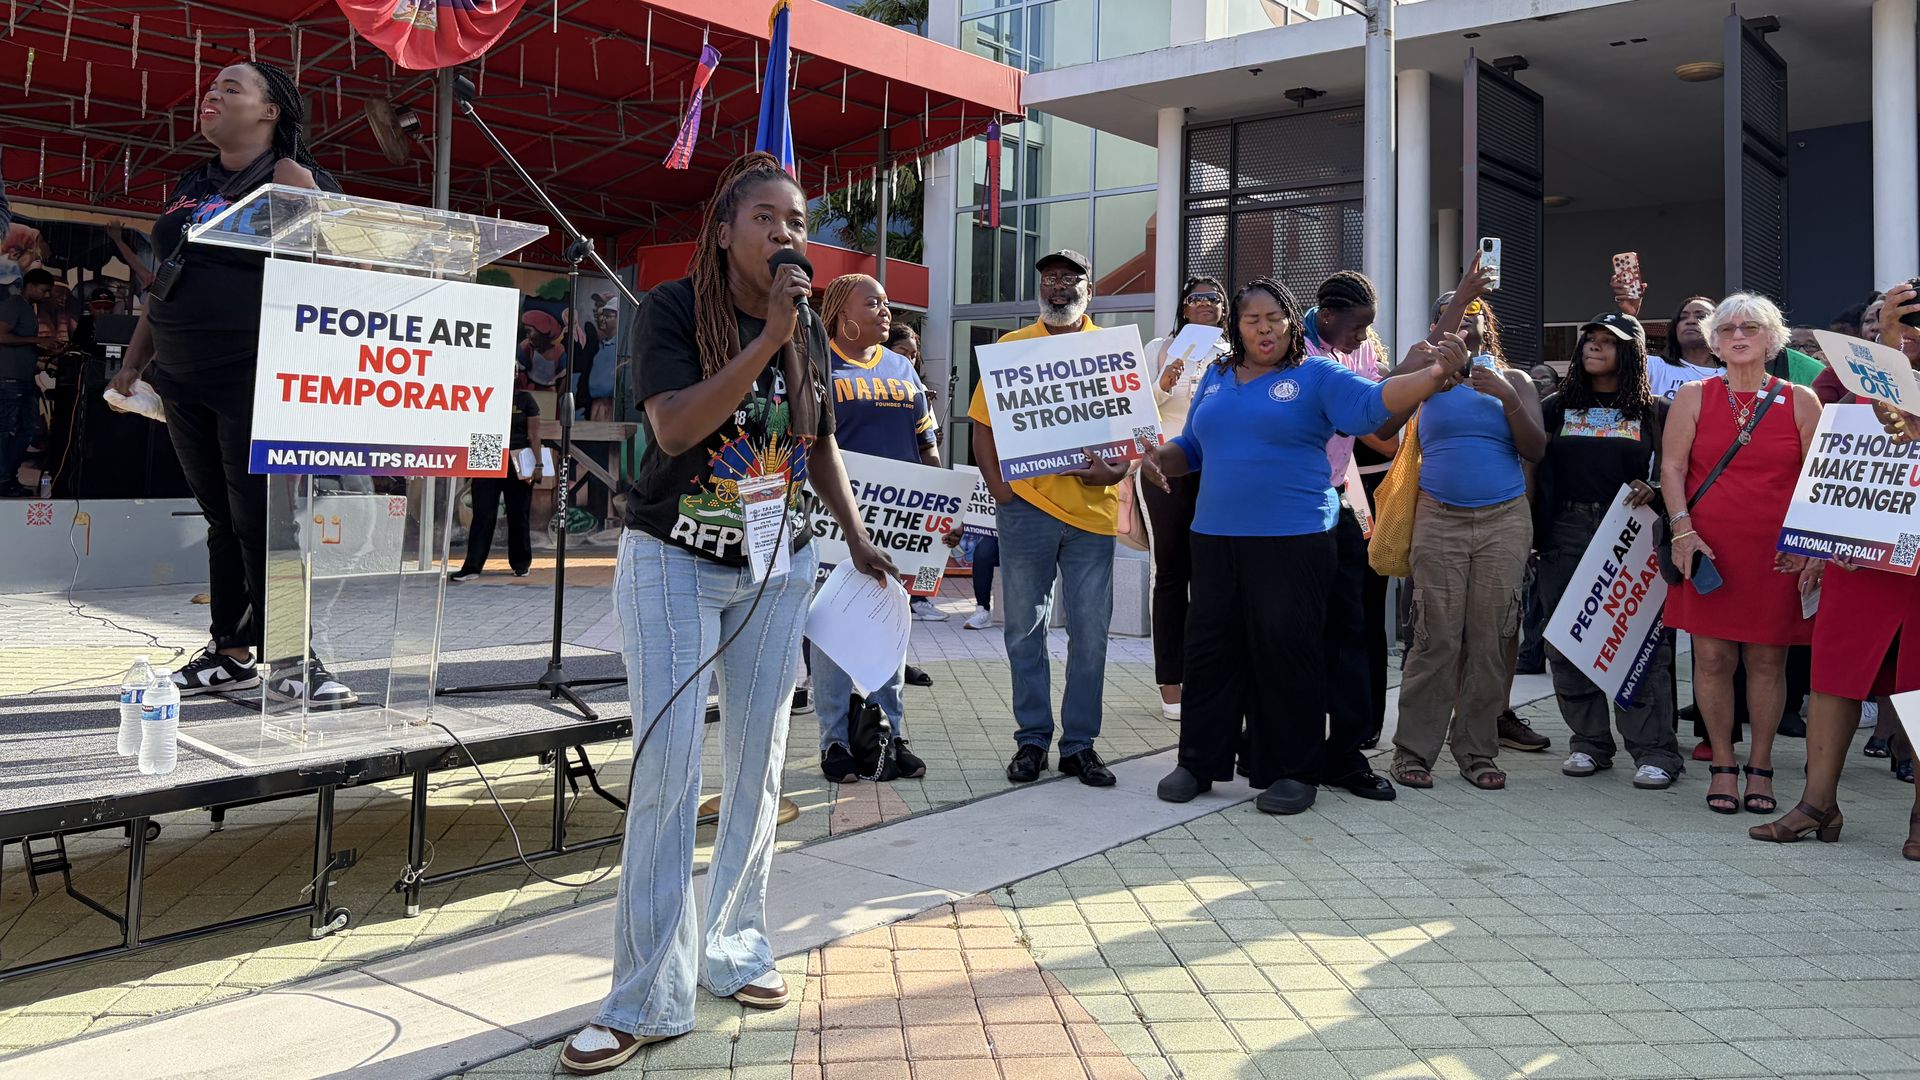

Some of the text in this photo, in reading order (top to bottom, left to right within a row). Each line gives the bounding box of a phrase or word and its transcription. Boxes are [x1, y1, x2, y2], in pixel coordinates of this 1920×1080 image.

[295, 304, 493, 350] PEOPLE ARE
[358, 344, 433, 377] NOT
[990, 351, 1137, 389] TPS HOLDERS
[276, 372, 495, 413] TEMPORARY
[834, 376, 917, 403] NAACP
[995, 372, 1142, 412] MAKE THE US
[1011, 396, 1132, 432] STRONGER
[267, 449, 457, 469] NATIONAL TPS RALLY
[1009, 455, 1071, 475] NATIONAL
[1071, 451, 1093, 464] TPS
[1818, 432, 1920, 460] TPS HOLDE
[1808, 457, 1920, 488] MAKE THE U
[811, 496, 954, 534] ME THE US
[861, 482, 962, 514] HOLDERS
[966, 503, 996, 516] STRO
[970, 493, 995, 505] AKE
[1809, 482, 1917, 515] STRONGER
[669, 513, 748, 559] REP
[813, 519, 933, 553] STNGER
[1783, 533, 1886, 562] NATIONAL TPS RALLY
[1569, 515, 1642, 644] PEOPLE ARE
[1602, 565, 1634, 618] NOT
[1592, 547, 1660, 673] TEMPORAR
[1621, 618, 1664, 701] NATIONAL TPS
